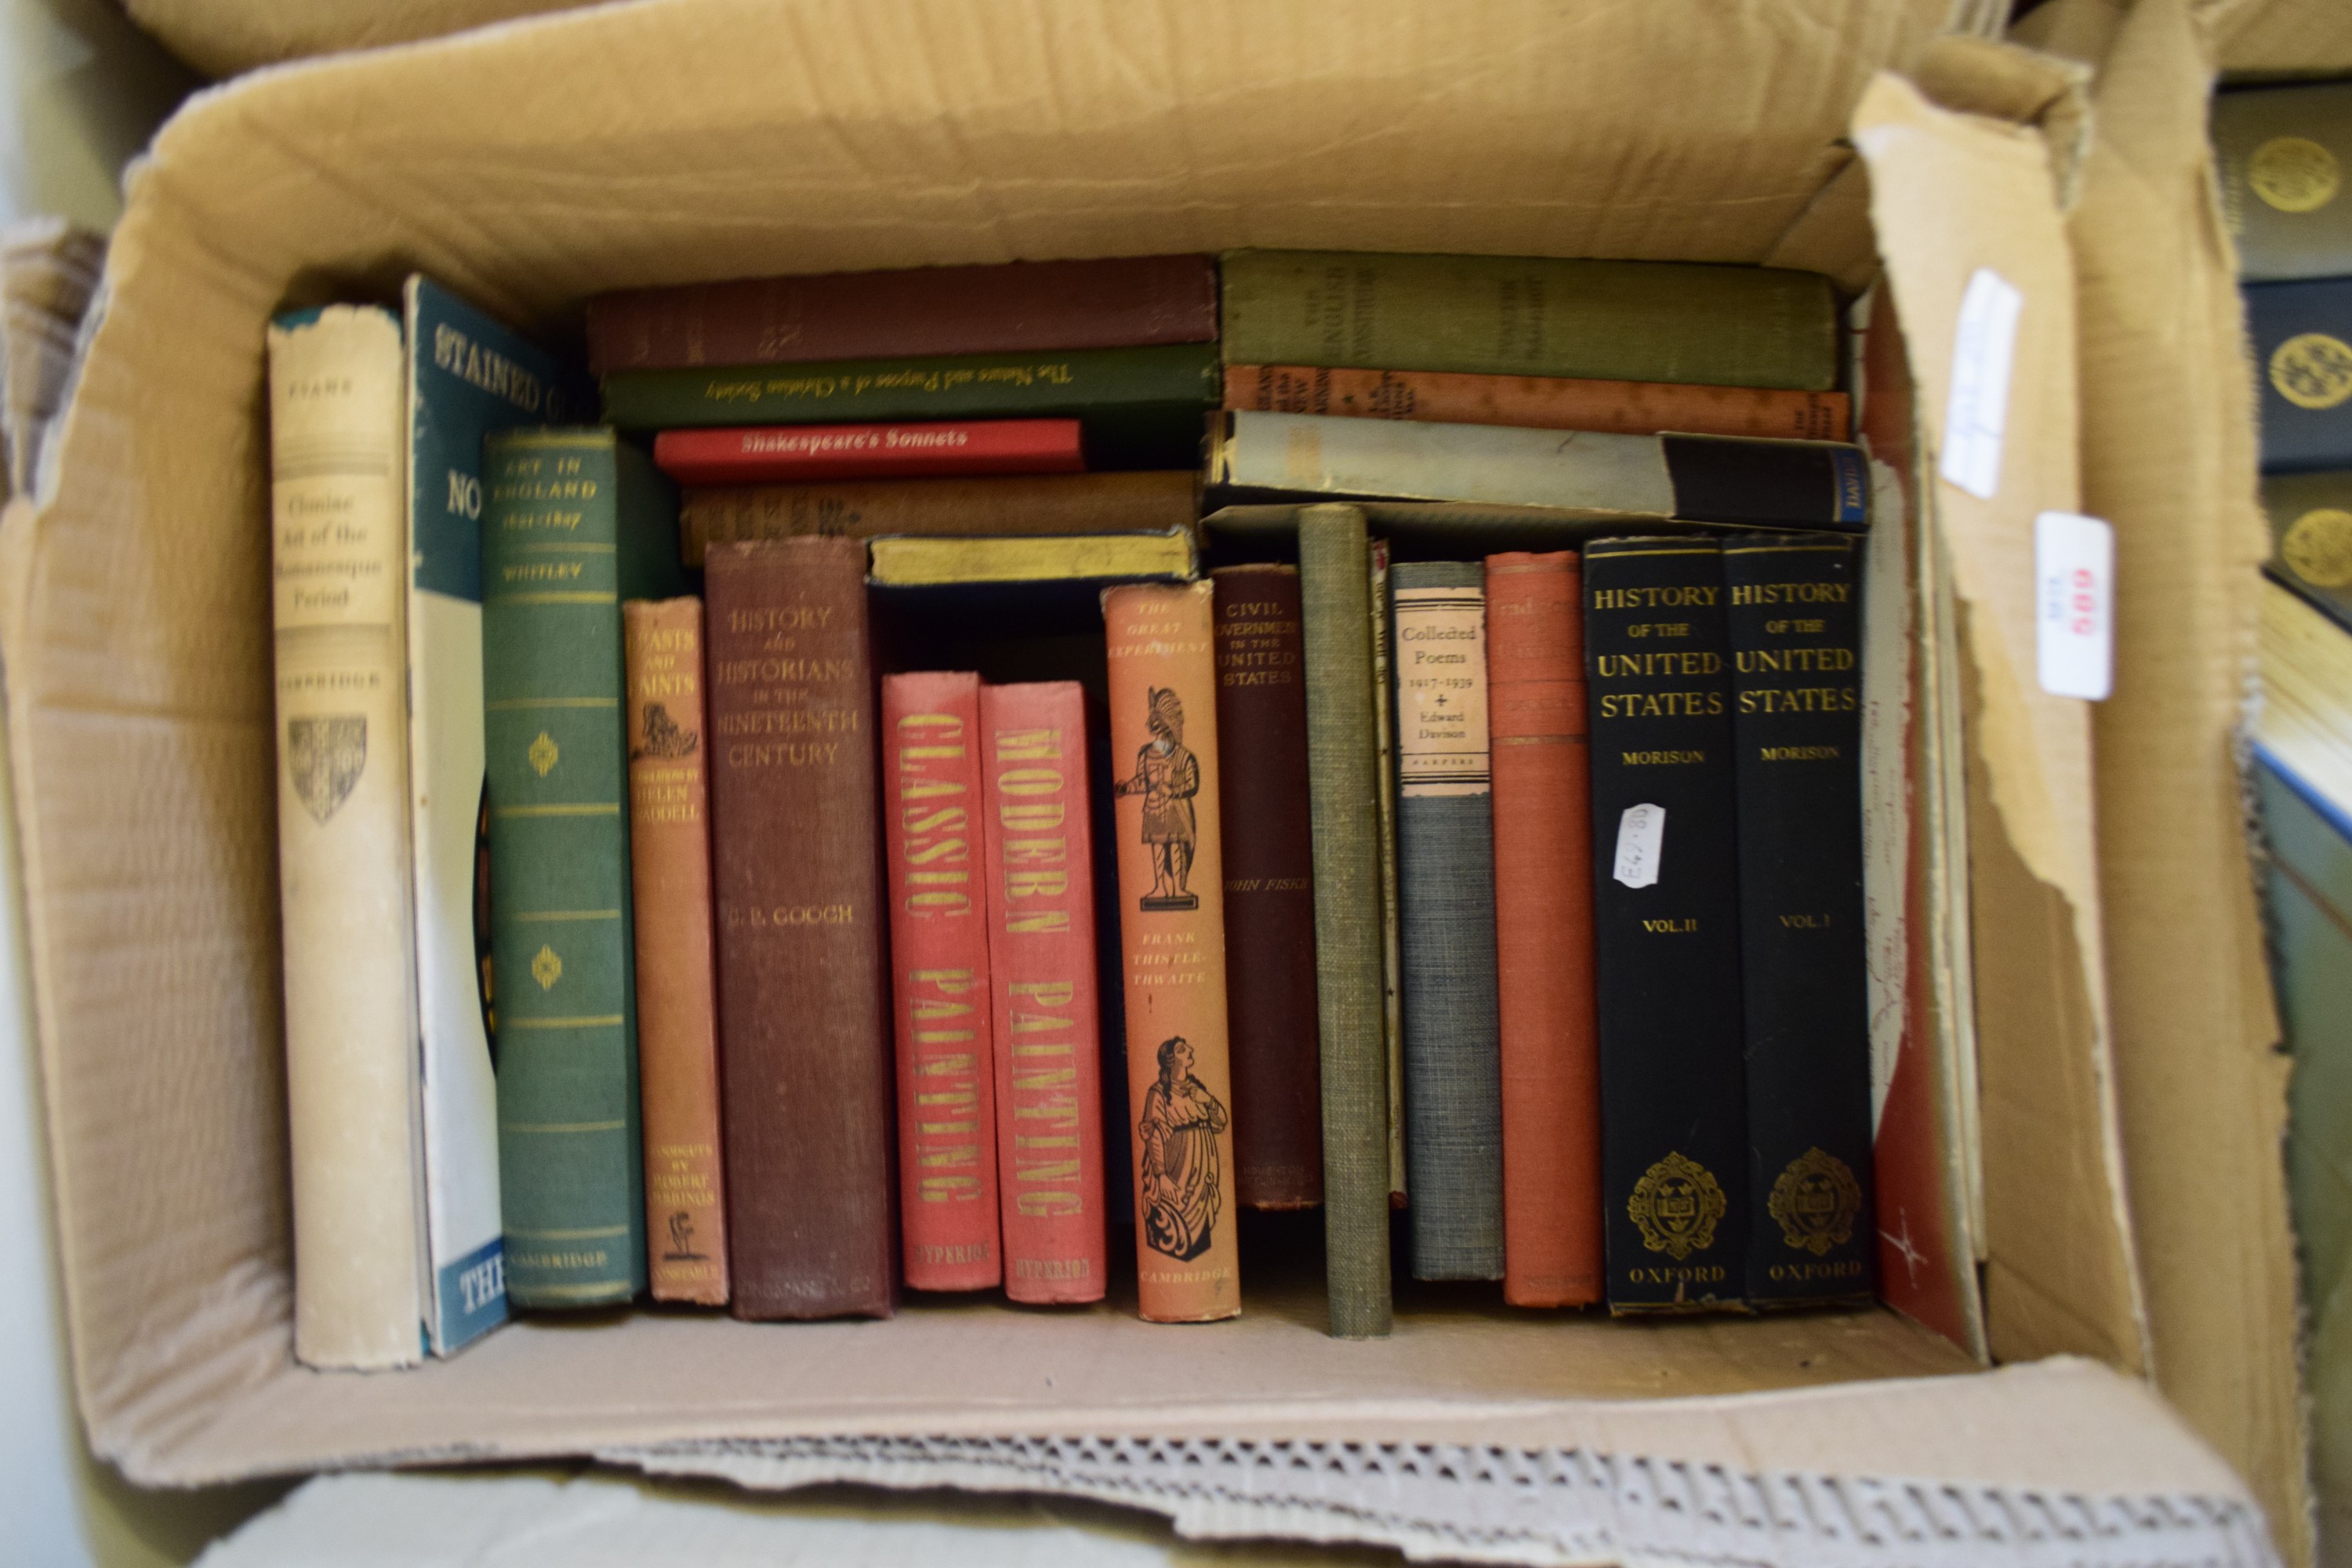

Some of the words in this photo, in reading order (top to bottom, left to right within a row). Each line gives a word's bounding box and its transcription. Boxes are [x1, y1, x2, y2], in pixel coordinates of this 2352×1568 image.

[434, 322, 541, 412] STAINED
[1036, 363, 1073, 384] The
[742, 429, 880, 456] Shakespeare's
[886, 427, 968, 448] Sonnets
[557, 457, 581, 476] IN
[493, 480, 597, 503] ENGLAND
[1595, 586, 1719, 609] HISTORY
[1731, 583, 1852, 605] HISTORY
[1226, 601, 1283, 617] CIVIL
[728, 607, 832, 633] HISTORY
[1215, 621, 1299, 637] OVERNMEN
[1628, 624, 1650, 637] OF
[1657, 622, 1690, 637] THE
[1766, 620, 1787, 633] OF
[1795, 619, 1825, 633] THE
[1250, 638, 1282, 649] THE
[1402, 626, 1476, 641] Collected
[1218, 652, 1295, 666] UNITED
[1415, 651, 1467, 665] Poems
[1598, 652, 1722, 677] UNITED
[1735, 648, 1855, 673] UNITED
[717, 659, 854, 684] HISTORIANS
[1223, 671, 1292, 687] STATES
[1409, 677, 1473, 690] 1917-1939
[1600, 692, 1723, 718] STATES
[1739, 688, 1856, 713] STATES
[1420, 710, 1465, 723] Edward
[1418, 728, 1466, 740] Davison
[728, 742, 839, 768] CENTURY
[1622, 750, 1705, 765] MORISON
[1761, 746, 1841, 761] MORISON
[897, 713, 972, 919] CLASSIC
[994, 728, 1071, 935] MODERN
[1265, 877, 1310, 891] FISKE
[772, 904, 853, 927] GOOCH
[1142, 931, 1196, 946] FRANK
[1133, 971, 1207, 985] THWAITE
[909, 967, 983, 1203] PAINTING
[1007, 980, 1083, 1219] PAINTING
[915, 1242, 990, 1265] HYPERION
[1015, 1257, 1091, 1281] HYPERION
[1140, 1267, 1232, 1283] CAMBRIDGE
[1629, 1265, 1726, 1284] OXFORD
[1769, 1259, 1863, 1281] OXFORD
